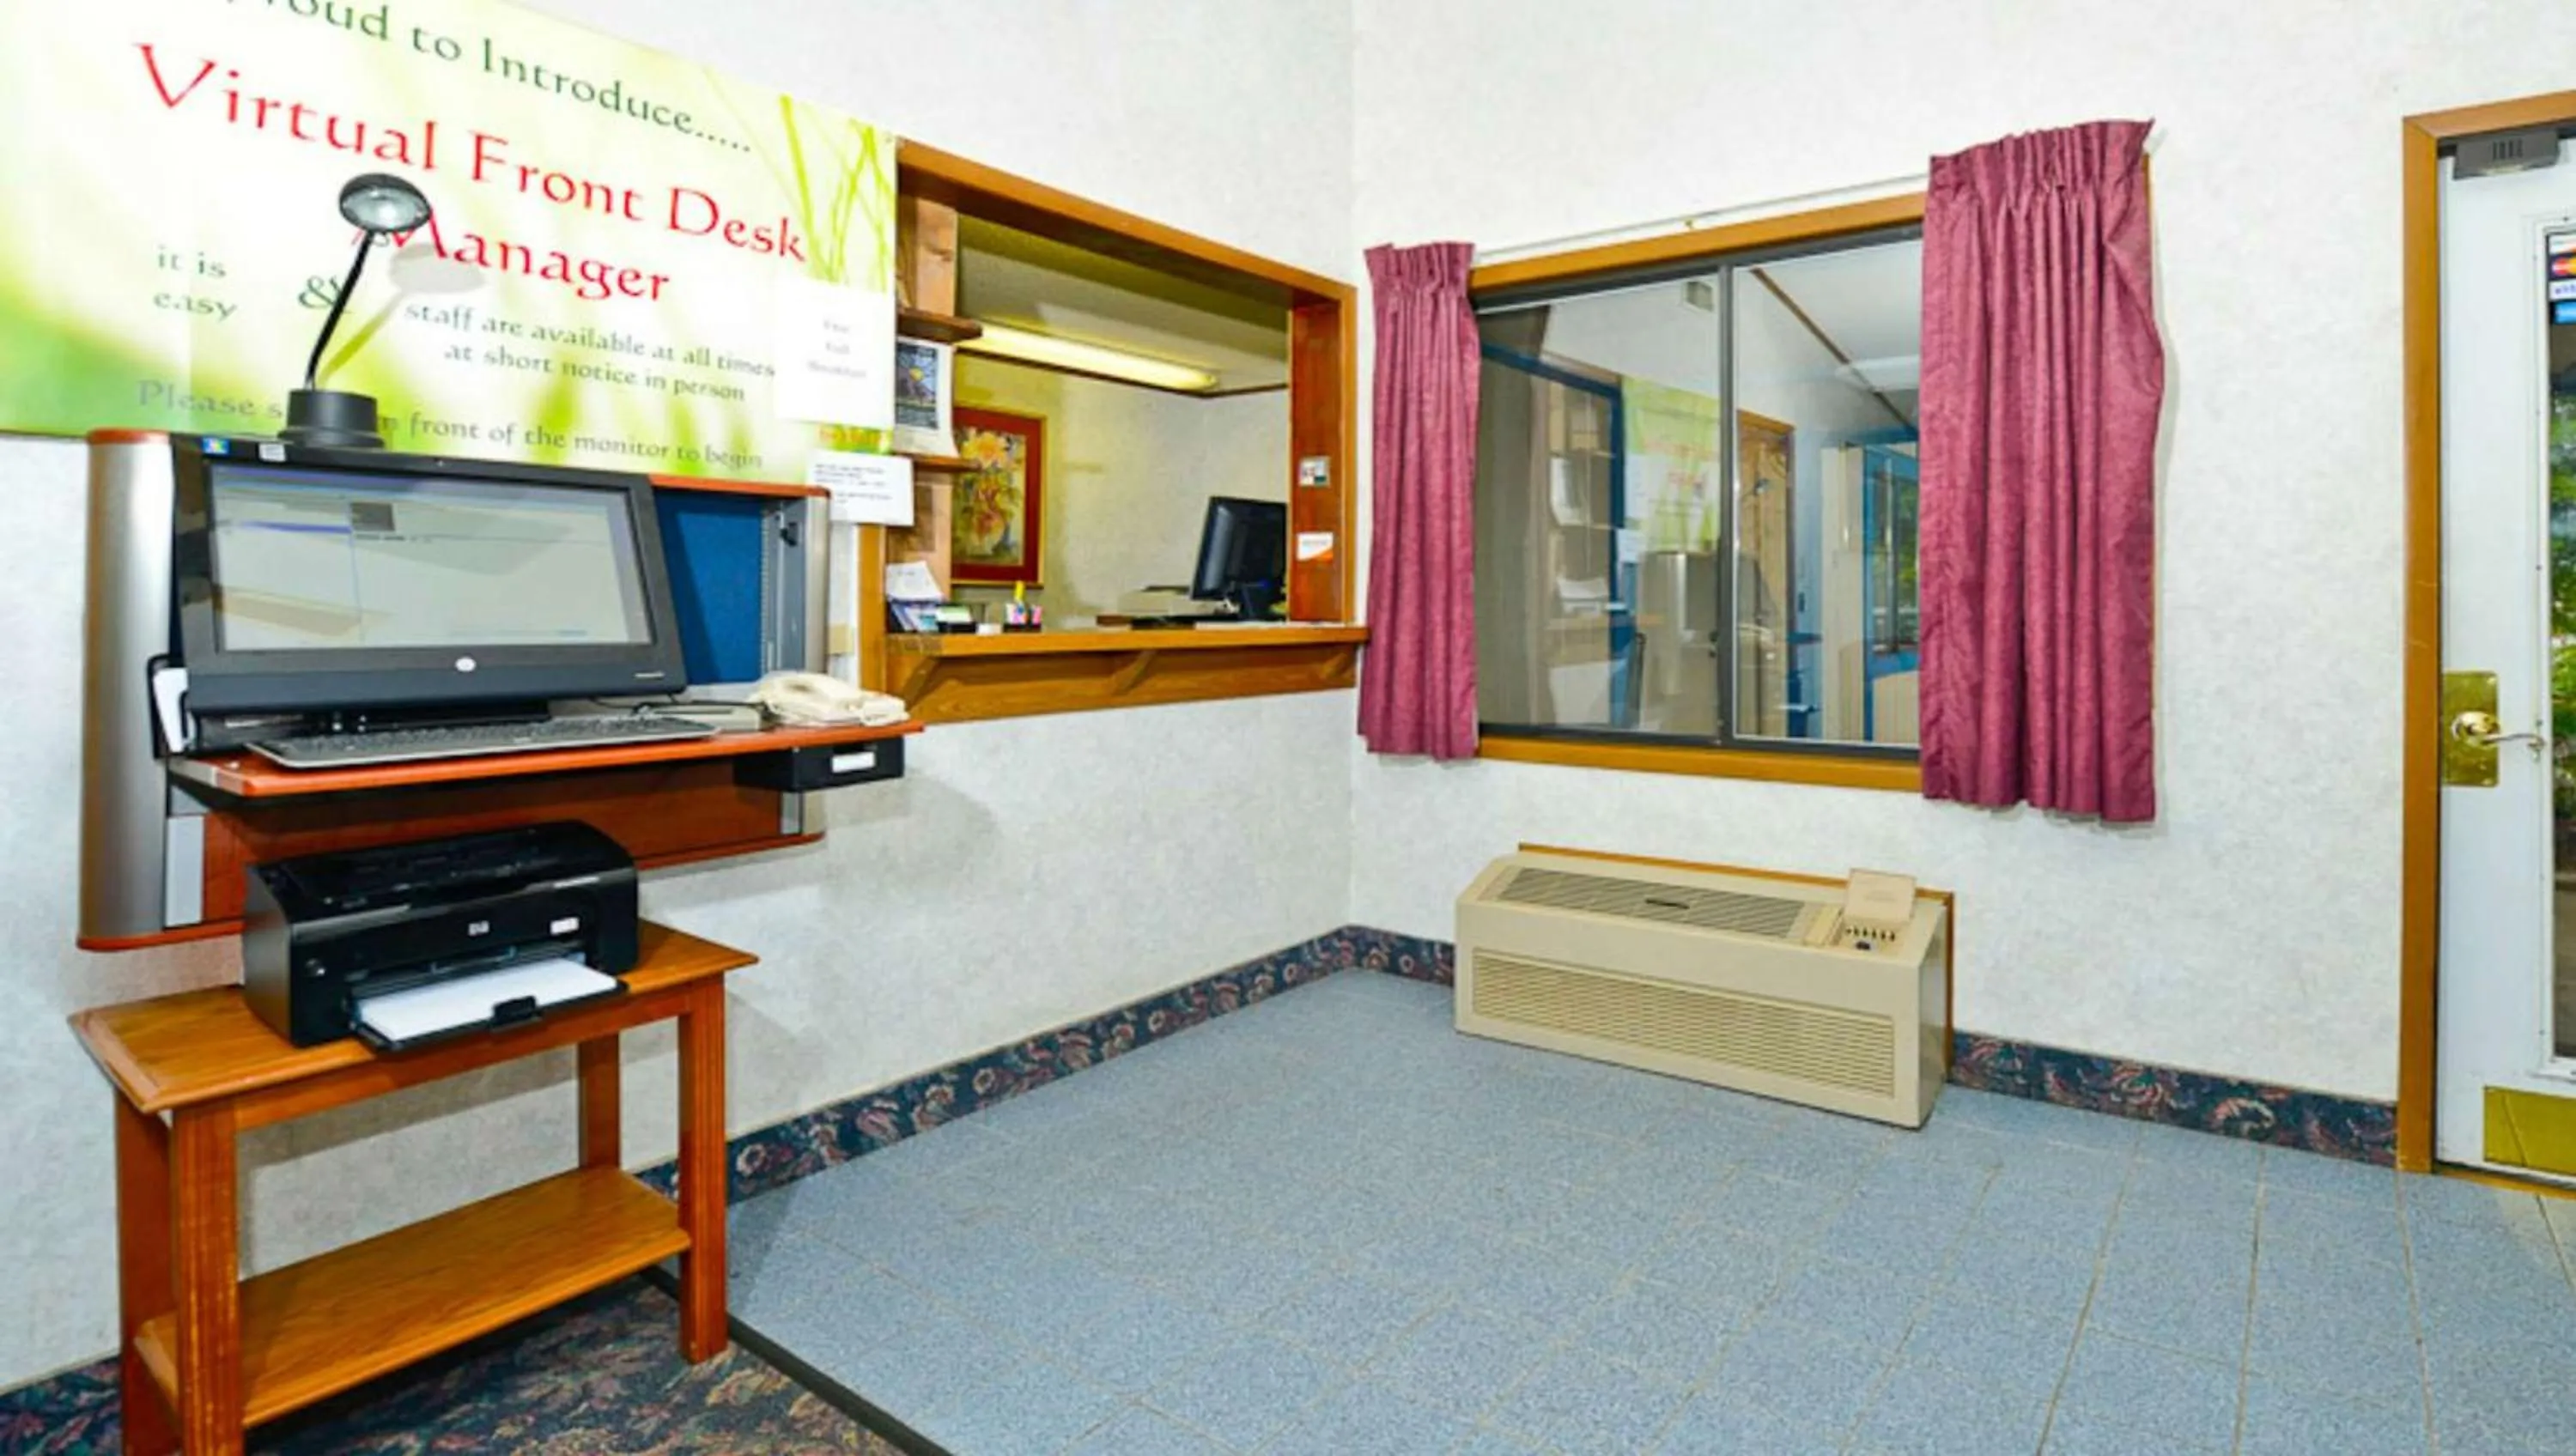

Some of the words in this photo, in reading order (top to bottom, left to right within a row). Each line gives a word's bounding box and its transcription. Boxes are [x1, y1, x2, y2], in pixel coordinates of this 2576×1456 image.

[227, 0, 388, 40] oud
[410, 26, 463, 61] to
[132, 43, 438, 170] Virtual
[470, 130, 644, 221] Front
[667, 185, 806, 262] Desk
[156, 244, 183, 271] it
[197, 251, 227, 278] is
[153, 291, 239, 321] easy
[404, 301, 475, 332] staff
[482, 318, 523, 337] are
[531, 323, 645, 356] available
[652, 347, 674, 361] at
[683, 349, 711, 369] all
[717, 354, 775, 378] times
[444, 344, 472, 361] at
[483, 345, 553, 373] short
[561, 361, 638, 386] notice
[646, 369, 666, 389] in
[674, 378, 745, 402] person
[139, 379, 257, 416] Please
[410, 410, 480, 440] front
[489, 424, 517, 446] of
[525, 426, 566, 449] the
[574, 436, 670, 458] monitor
[677, 445, 700, 464] to
[703, 446, 763, 470] begin
